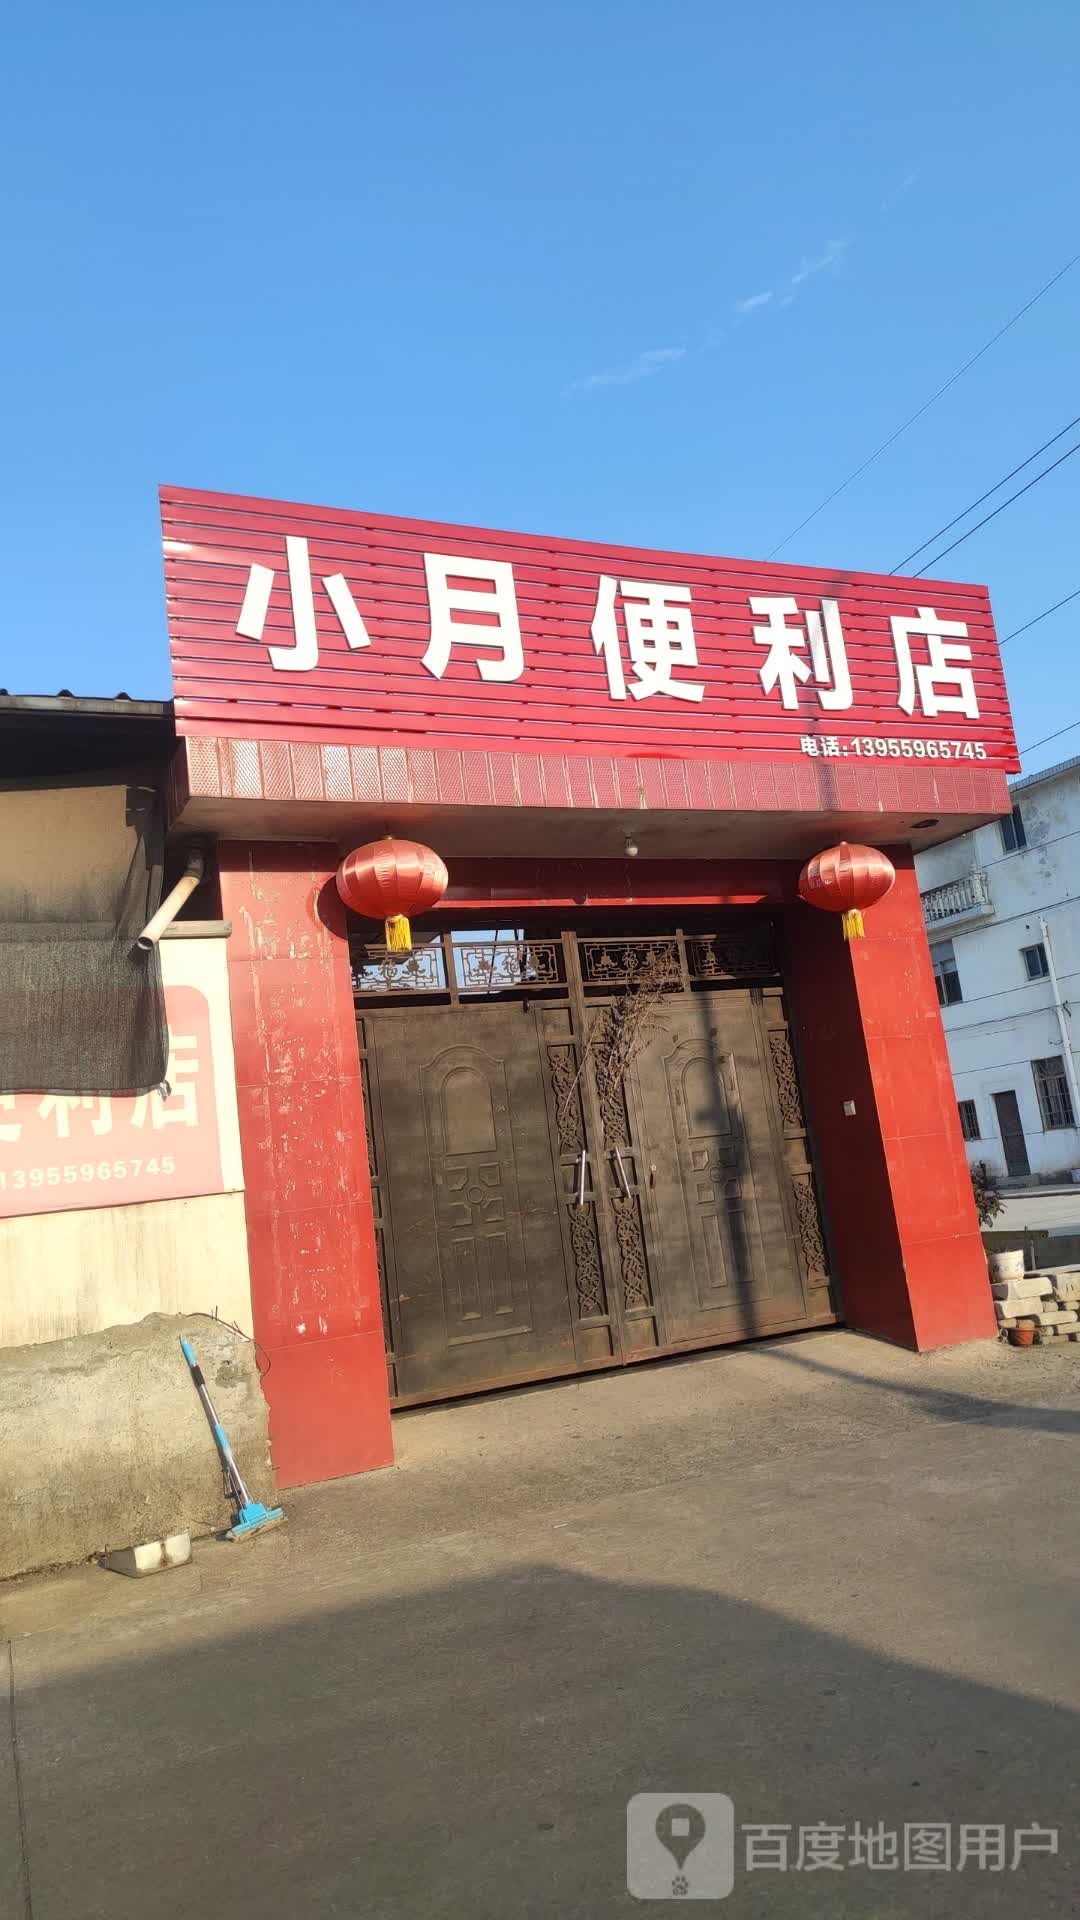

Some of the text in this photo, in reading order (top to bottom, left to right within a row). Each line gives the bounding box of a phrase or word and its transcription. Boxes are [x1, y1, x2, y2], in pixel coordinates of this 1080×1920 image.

[234, 535, 982, 721] 小月便利店
